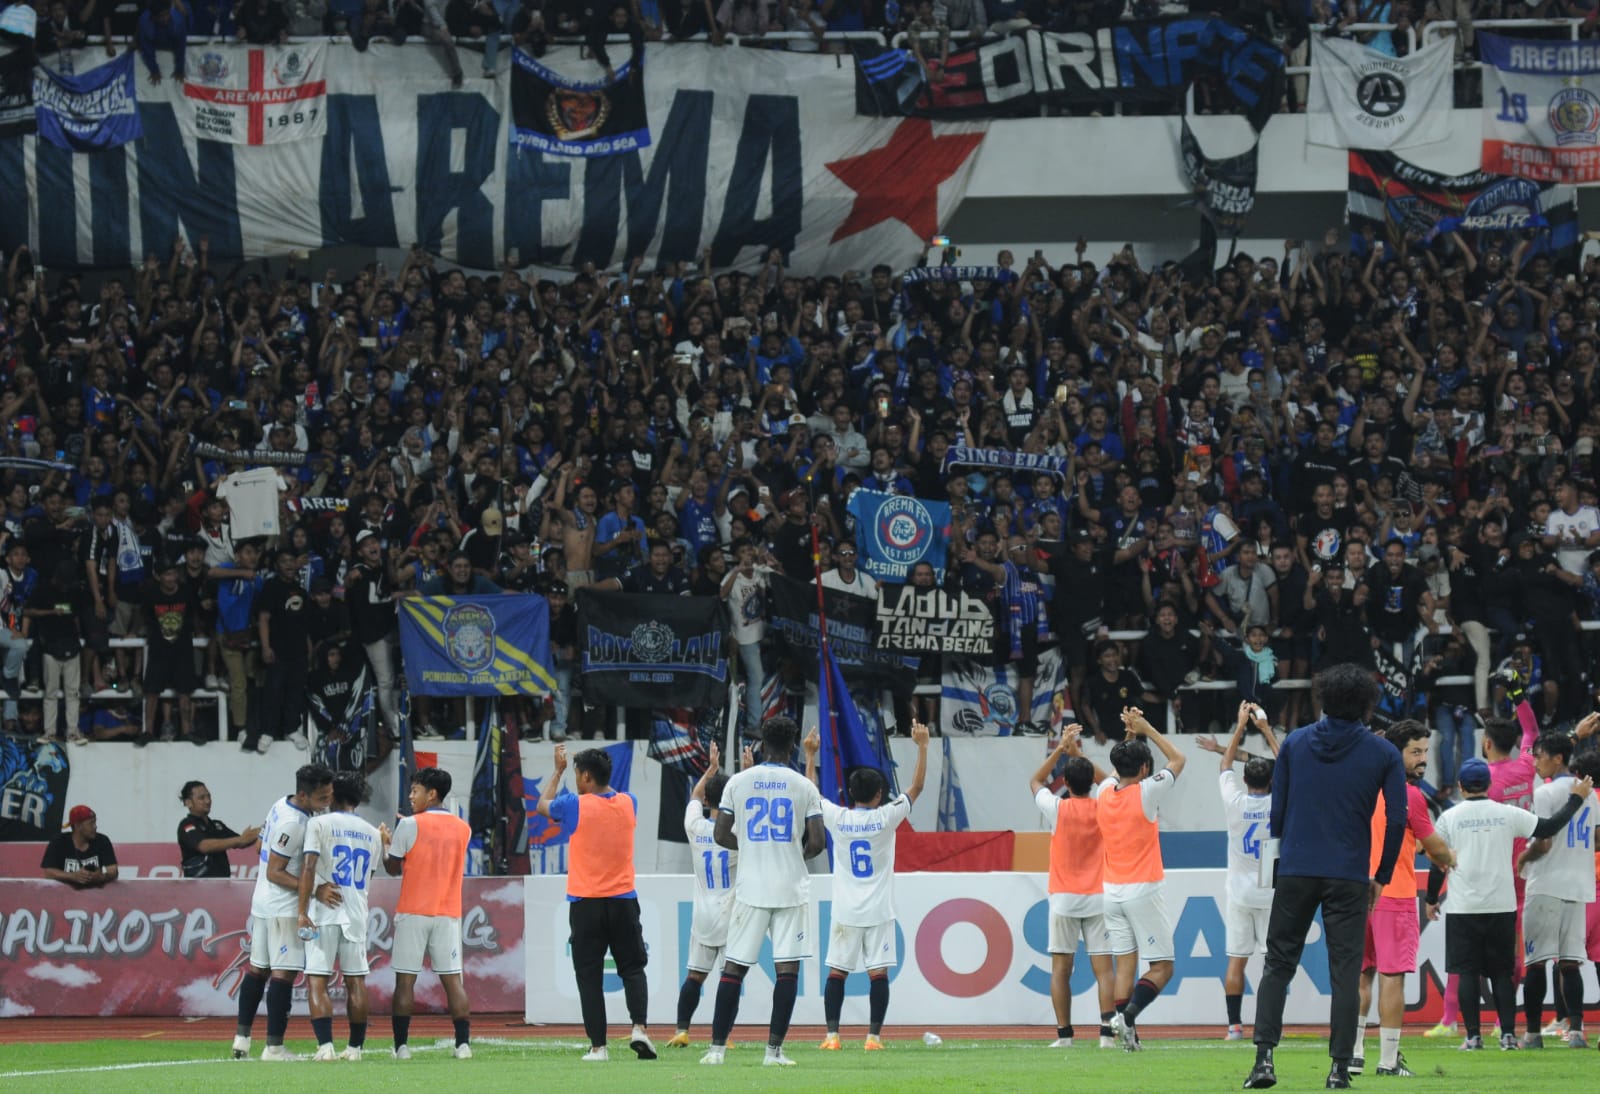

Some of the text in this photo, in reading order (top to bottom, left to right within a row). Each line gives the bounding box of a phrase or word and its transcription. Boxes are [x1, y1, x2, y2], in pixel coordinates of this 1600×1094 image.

[1509, 45, 1600, 70] AREMA
[214, 89, 297, 102] AREMANIA
[1460, 214, 1507, 228] AREMA
[903, 266, 942, 282] SING
[955, 447, 1067, 471] SING EDAN
[884, 499, 914, 518] AREMA
[753, 780, 787, 791] CAMARA
[745, 797, 794, 842] 29
[1567, 806, 1591, 849] 14
[332, 845, 371, 889] 30
[702, 851, 730, 889] 11
[849, 840, 874, 878] 6
[0, 908, 216, 955] ALIKOTA
